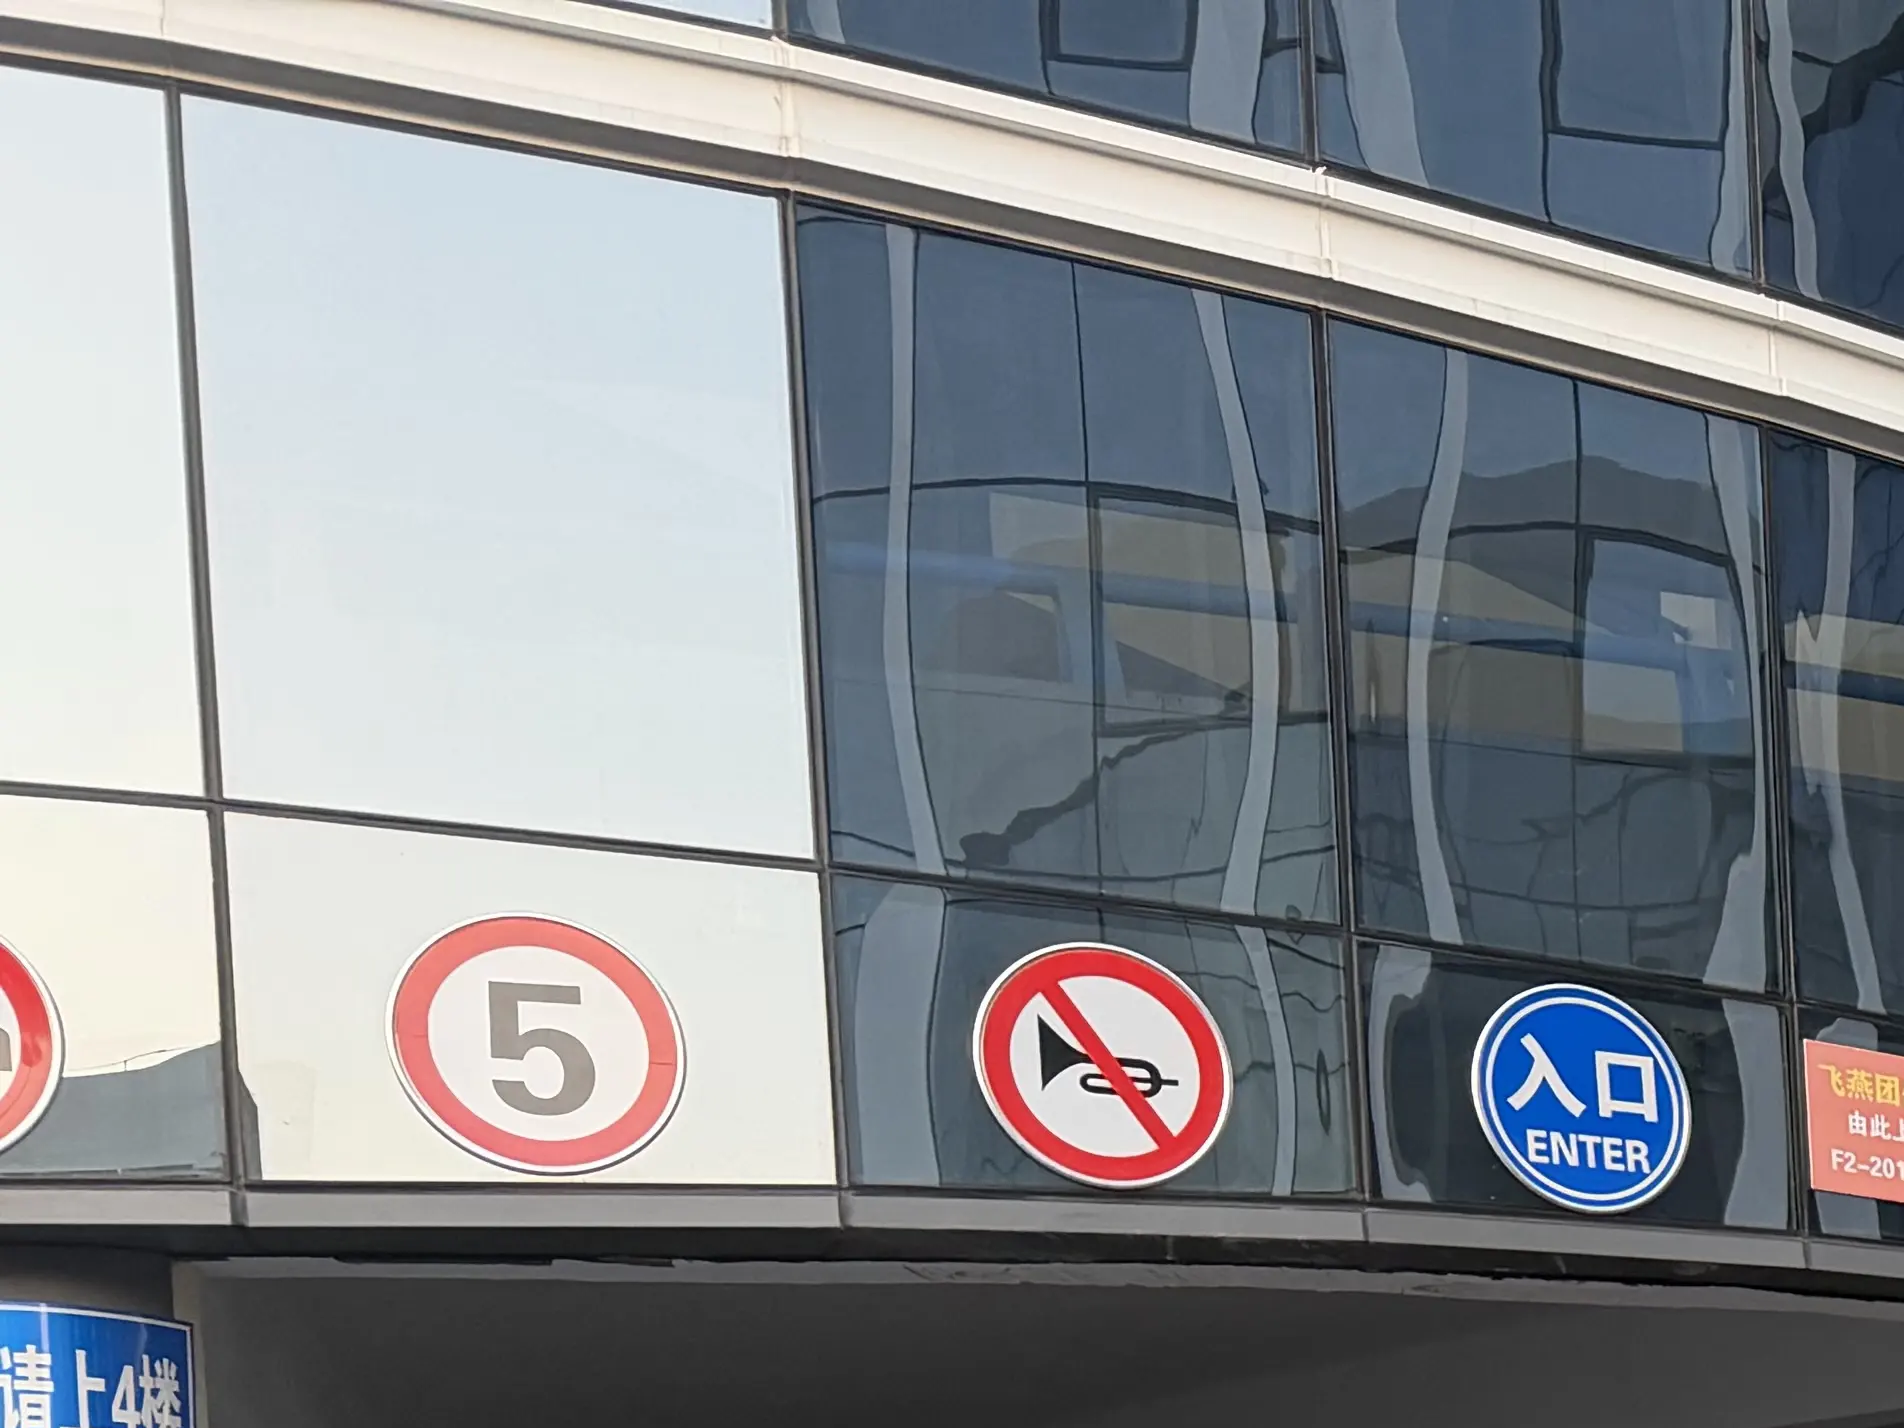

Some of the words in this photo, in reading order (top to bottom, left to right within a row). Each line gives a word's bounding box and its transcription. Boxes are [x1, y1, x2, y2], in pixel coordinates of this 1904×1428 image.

[488, 981, 596, 1116] 5
[1507, 1033, 1659, 1123] 入口
[1526, 1128, 1651, 1174] ENTER
